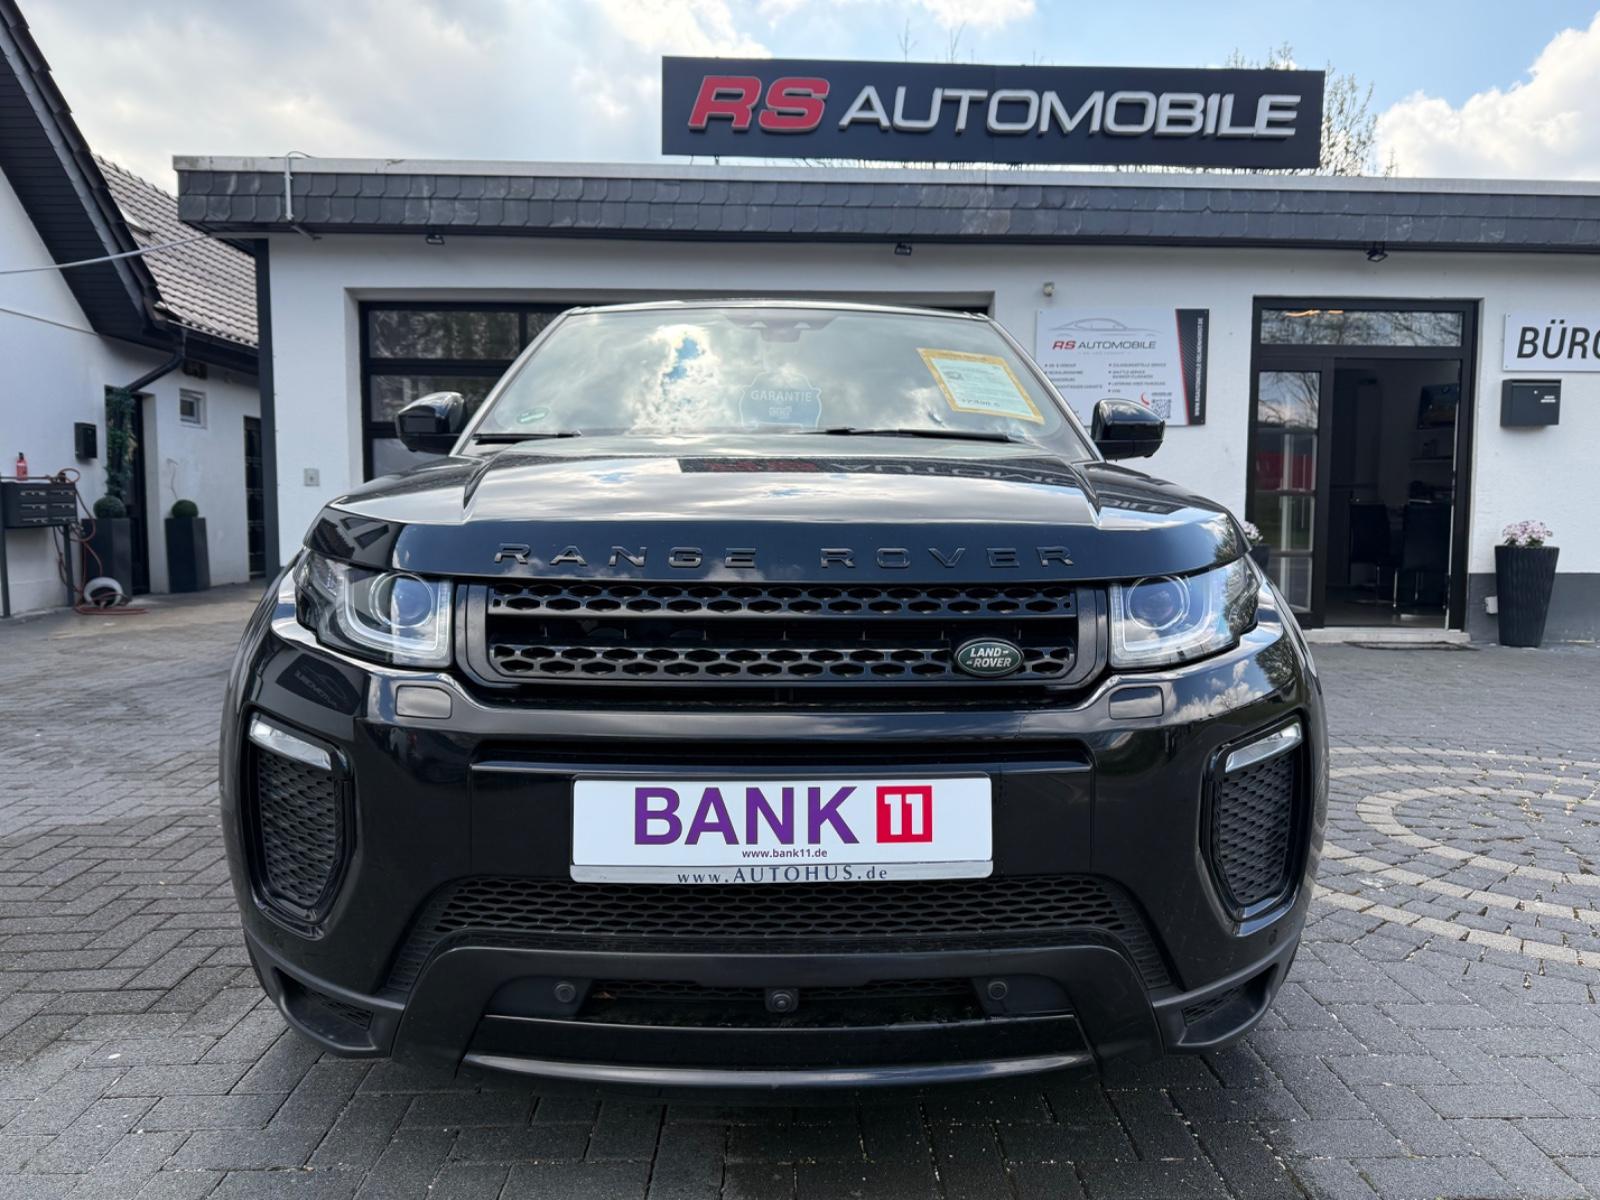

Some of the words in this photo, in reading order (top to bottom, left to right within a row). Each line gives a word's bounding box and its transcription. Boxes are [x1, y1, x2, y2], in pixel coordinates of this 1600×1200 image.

[688, 75, 830, 133] RS
[838, 85, 1301, 139] AUTOMOBILE
[1052, 340, 1076, 350] RS
[1077, 340, 1157, 350] AUTOMOBILE
[751, 390, 812, 402] GARANTIE
[494, 543, 758, 569] RANGE
[820, 545, 1075, 569] ROVER
[634, 786, 860, 845] BANK
[884, 793, 924, 836] 11
[742, 848, 828, 860] www.bank11.de
[677, 864, 888, 884] www.AUTOHUS.de
